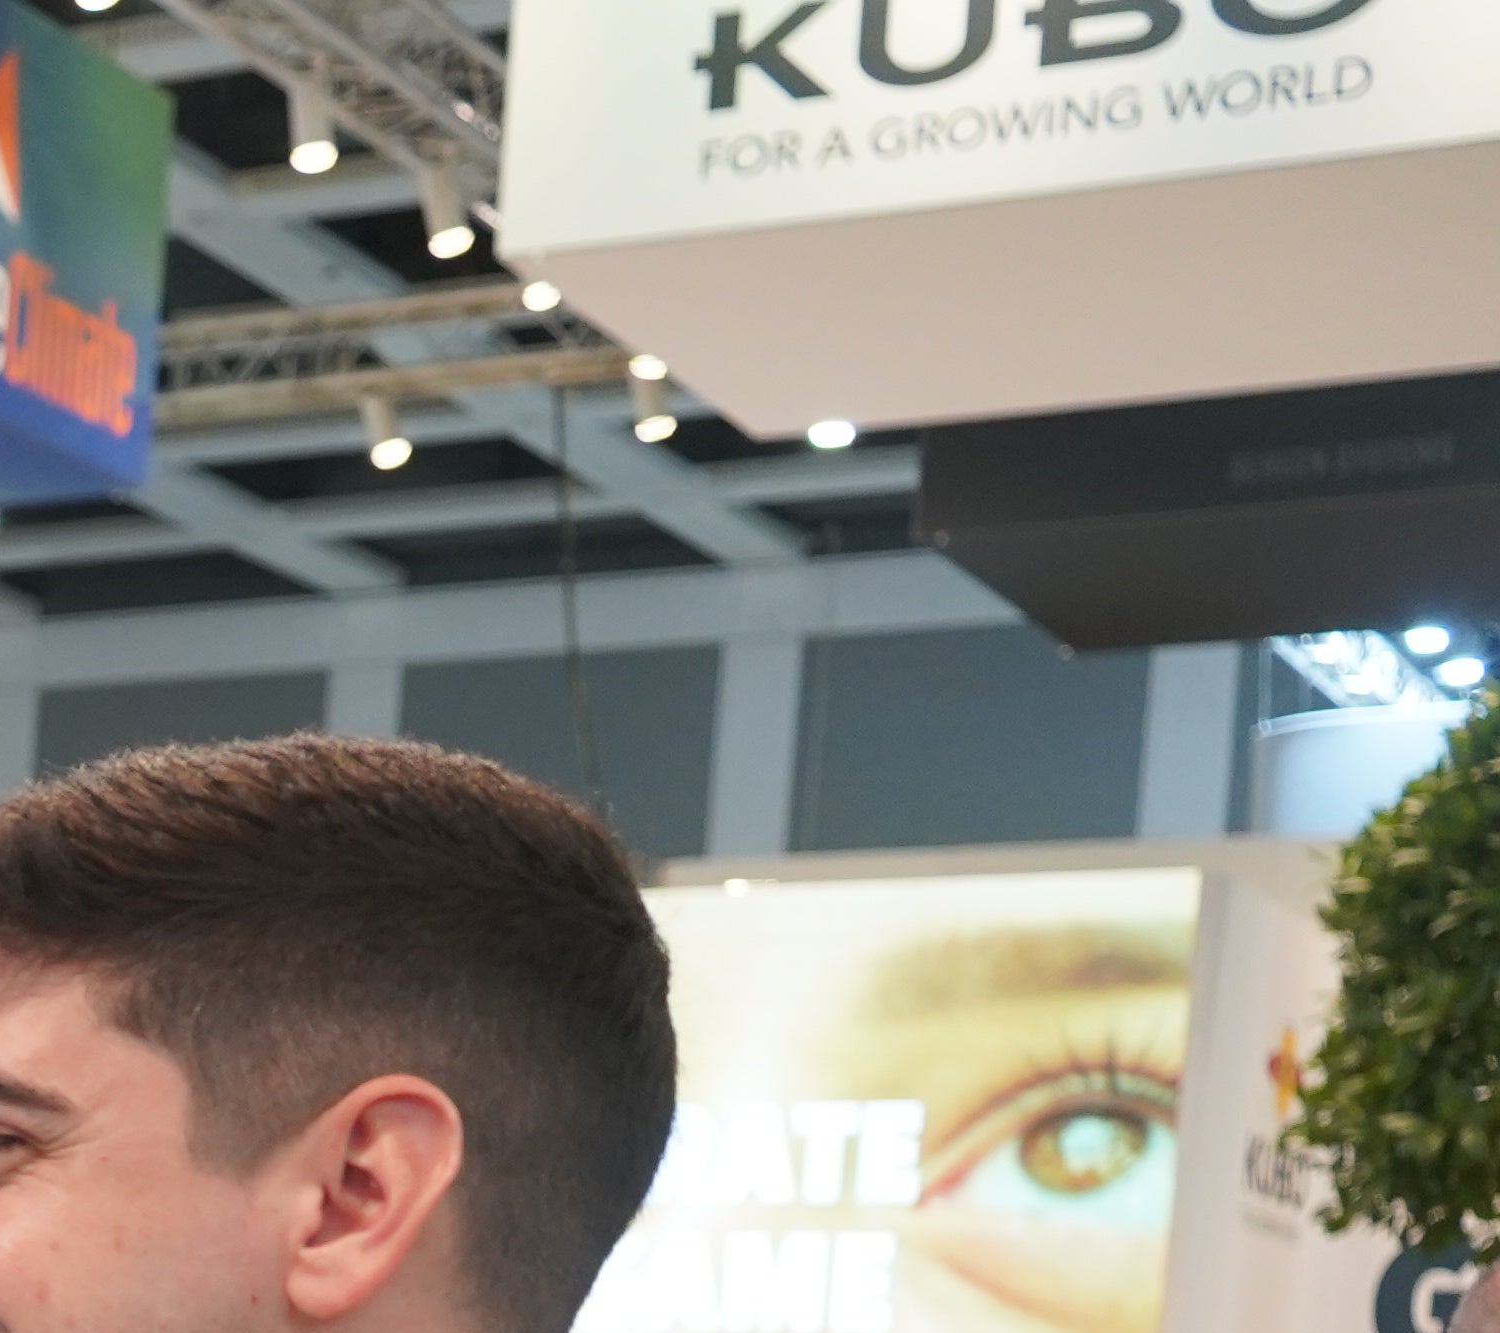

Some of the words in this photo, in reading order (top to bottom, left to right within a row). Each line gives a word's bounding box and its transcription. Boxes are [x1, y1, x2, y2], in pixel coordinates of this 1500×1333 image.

[698, 131, 802, 179] FOR
[817, 127, 854, 164] A
[870, 85, 1144, 160] GROWING
[1162, 56, 1374, 118] WORLD
